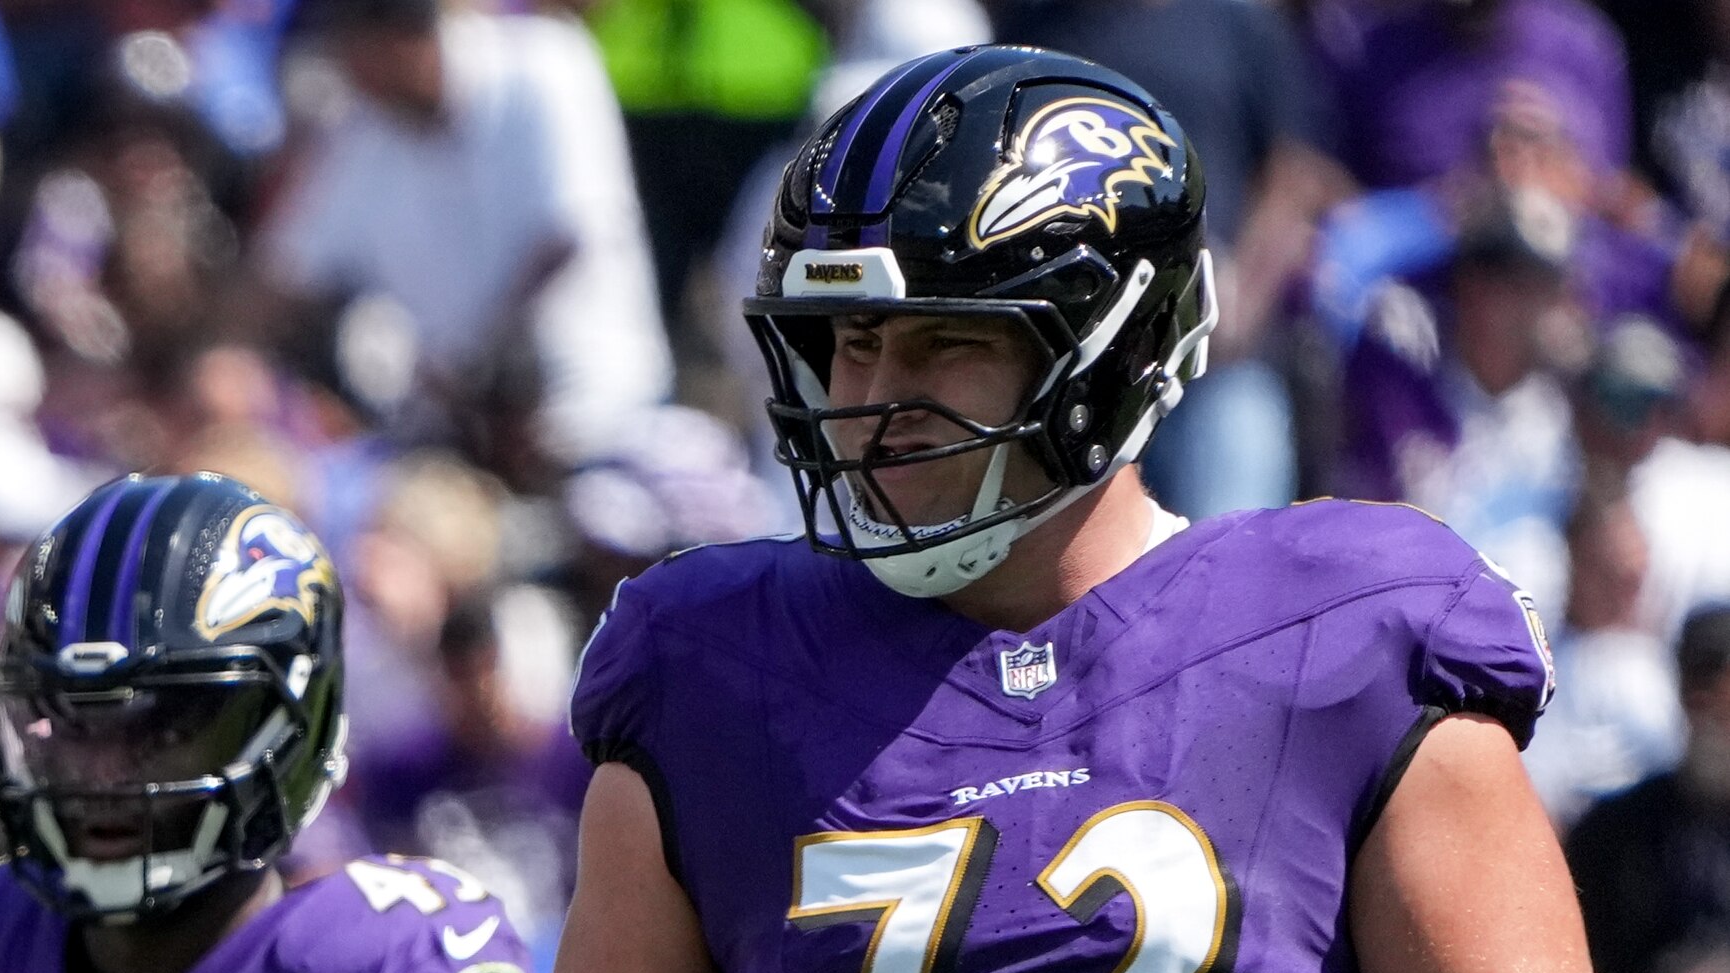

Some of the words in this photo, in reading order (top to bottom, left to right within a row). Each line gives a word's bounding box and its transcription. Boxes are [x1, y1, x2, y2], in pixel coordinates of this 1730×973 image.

[804, 262, 864, 283] RAVENS
[1009, 664, 1046, 689] NFL
[950, 767, 1090, 805] RAVENS
